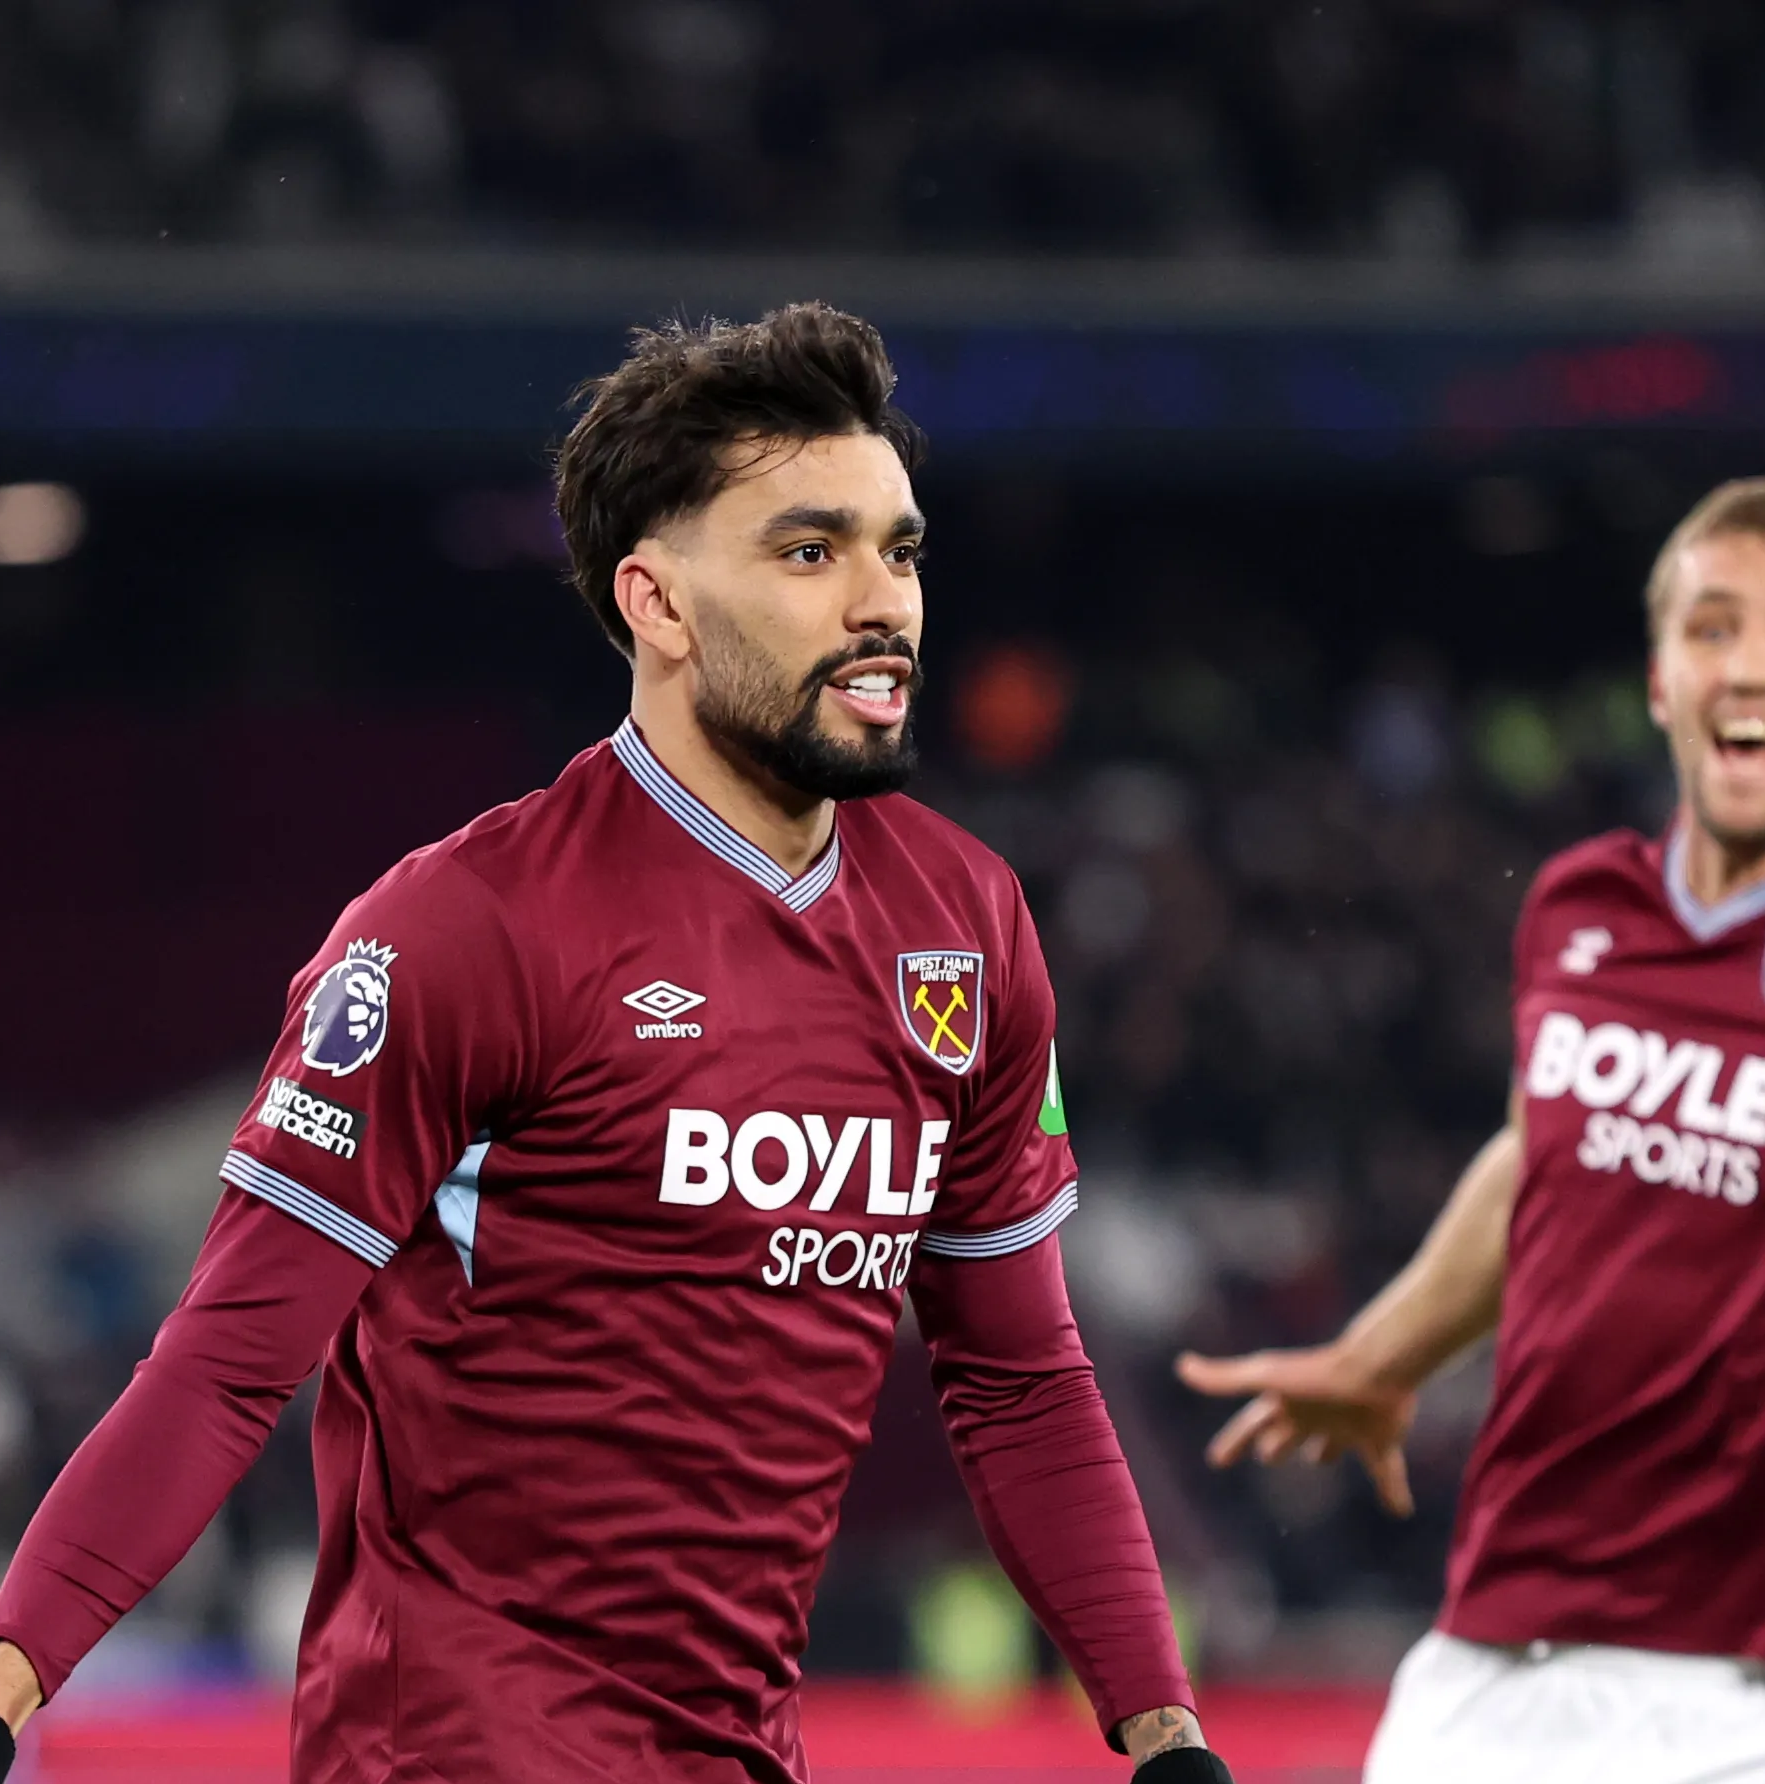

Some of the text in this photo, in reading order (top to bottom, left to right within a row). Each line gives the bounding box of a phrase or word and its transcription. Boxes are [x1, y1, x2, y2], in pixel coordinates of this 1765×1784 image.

[907, 956, 974, 973] WEST HAM
[920, 969, 960, 982] UNITED
[635, 1020, 702, 1039] umbro
[275, 1108, 356, 1159] racism
[285, 1089, 353, 1134] room
[659, 1108, 951, 1215] BOYLE
[1576, 1110, 1761, 1206] SPORTS
[762, 1226, 919, 1290] SPORTS
